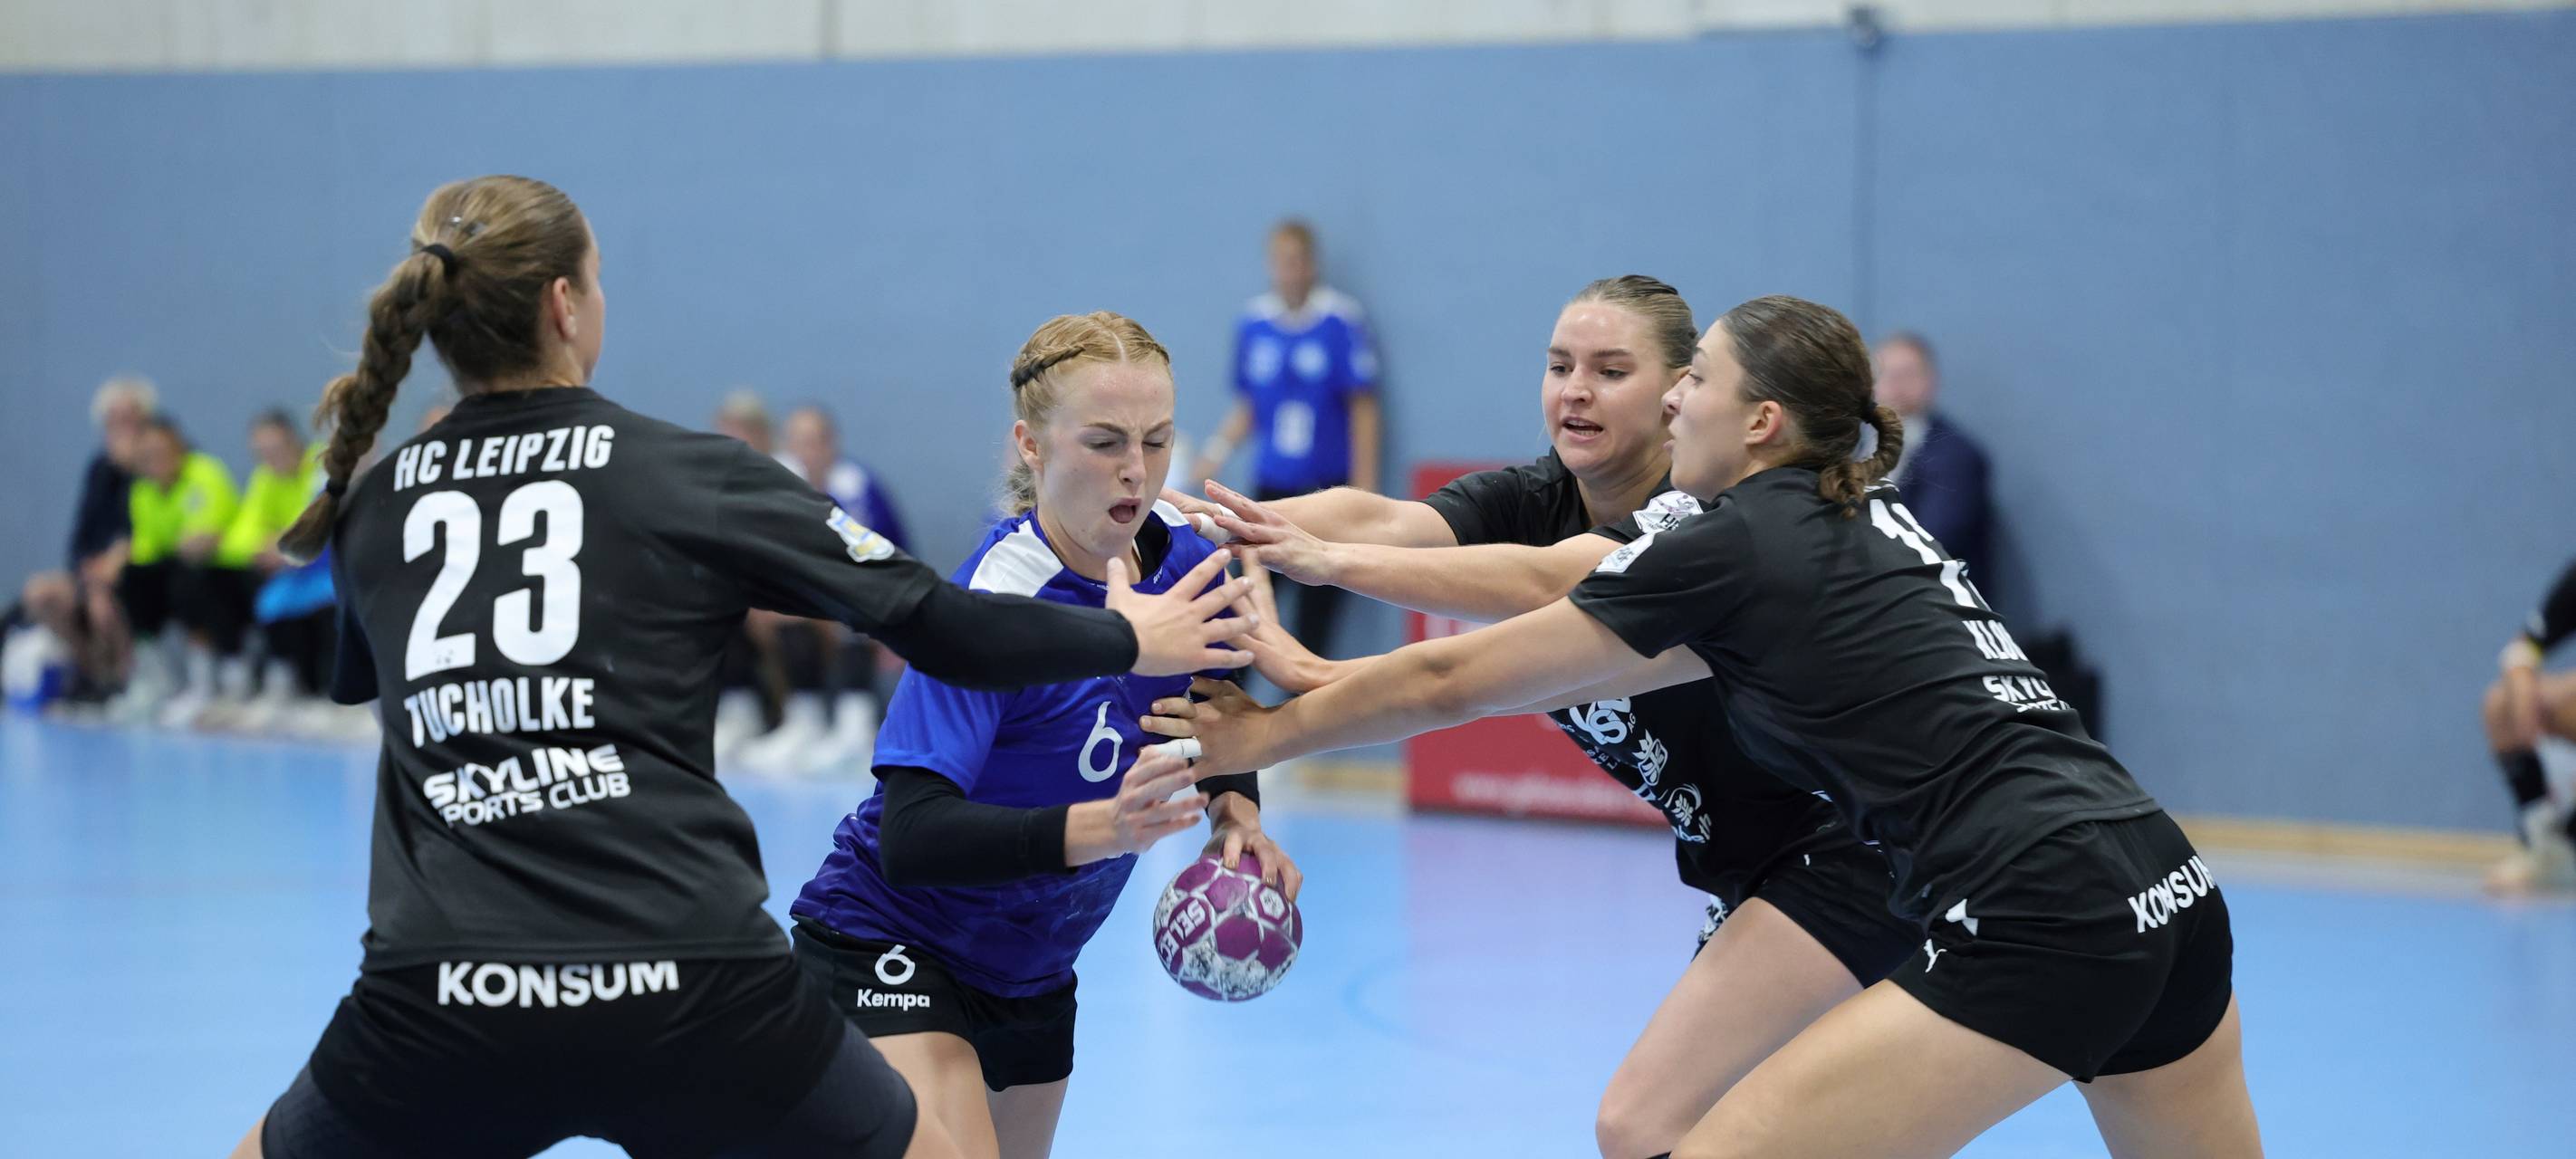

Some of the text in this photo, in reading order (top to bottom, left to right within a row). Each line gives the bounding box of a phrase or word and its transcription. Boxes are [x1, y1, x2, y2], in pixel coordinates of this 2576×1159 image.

[393, 424, 615, 491] HC LEIPZIG
[402, 479, 584, 681] 23
[404, 677, 596, 748] TUCHOLKE
[1078, 701, 1122, 783] 6
[423, 743, 625, 809] SKYLINE
[438, 771, 631, 828] PORTS CLUB
[437, 961, 679, 1008] KONSUM
[874, 943, 916, 985] 6
[857, 989, 930, 1011] Kempa
